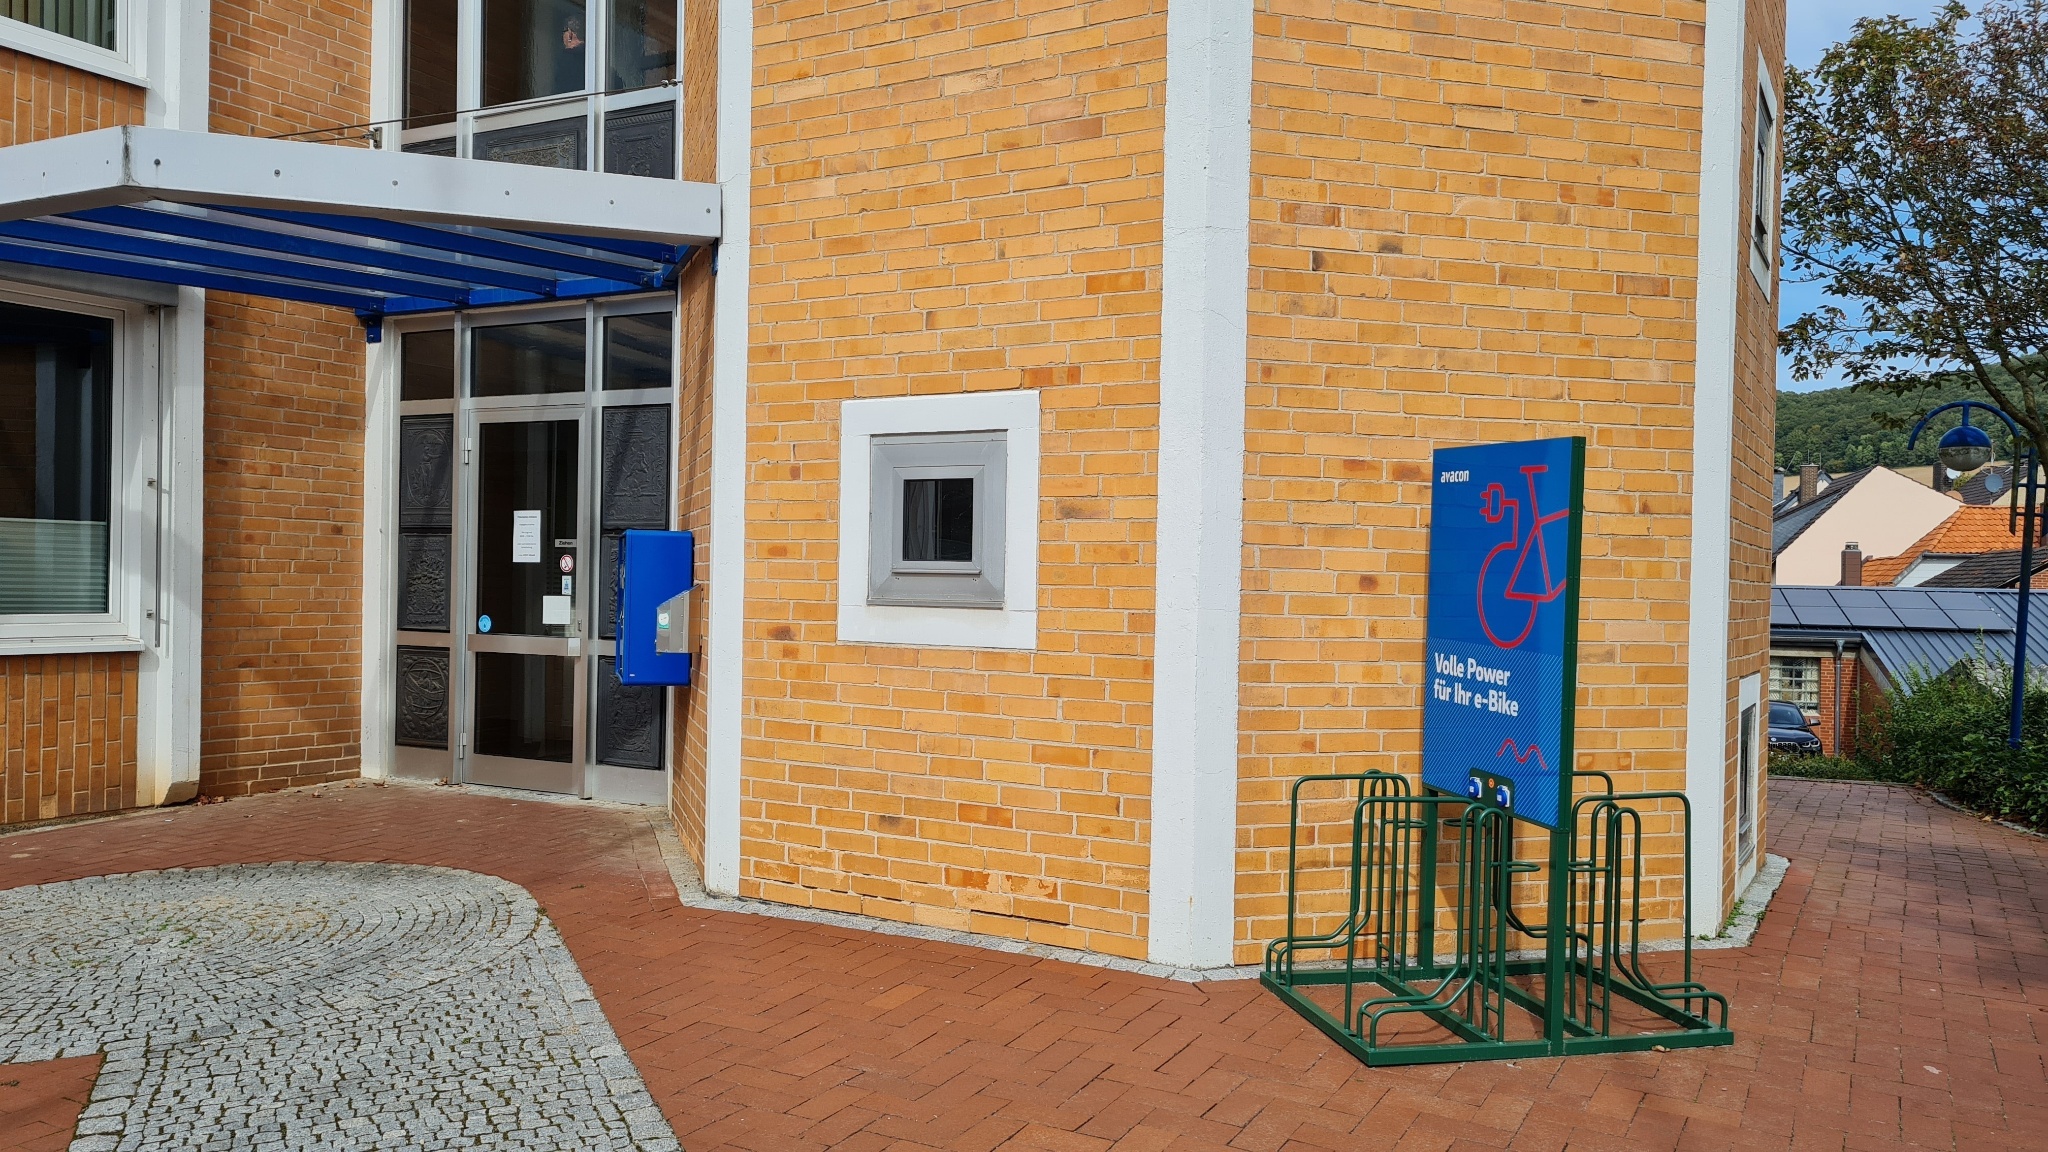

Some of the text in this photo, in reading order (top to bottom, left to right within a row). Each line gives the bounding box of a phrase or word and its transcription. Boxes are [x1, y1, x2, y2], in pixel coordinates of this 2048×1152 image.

[1440, 470, 1469, 483] avacon
[1435, 652, 1510, 686] Volle Power
[1434, 678, 1519, 717] für Ihr e-Bike
